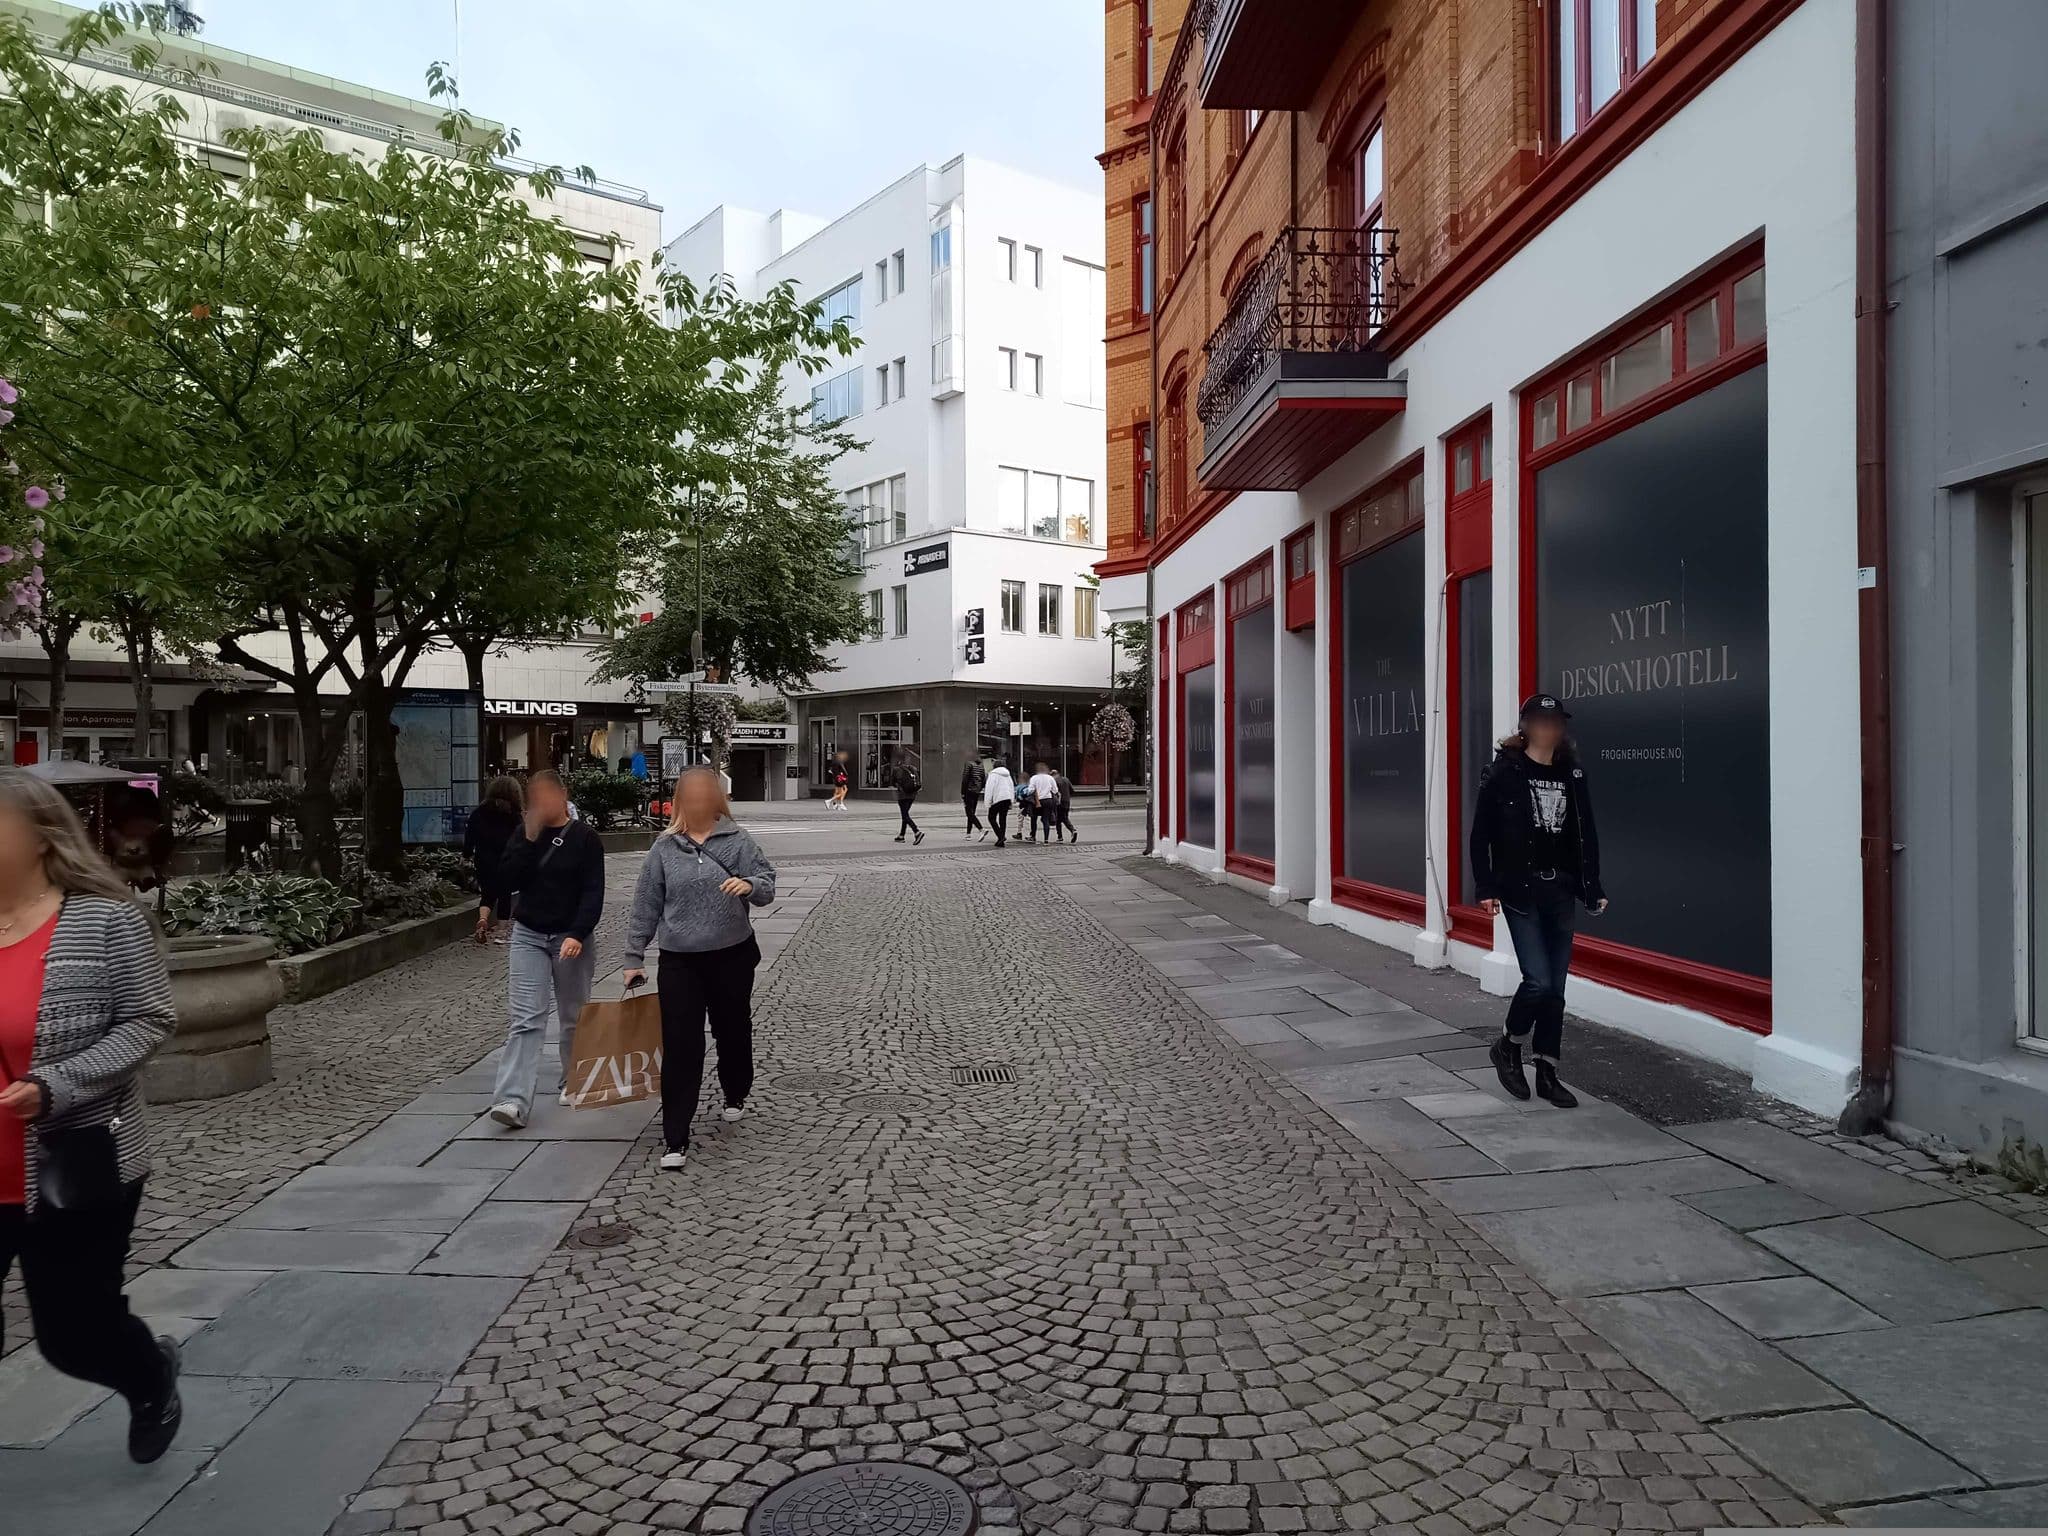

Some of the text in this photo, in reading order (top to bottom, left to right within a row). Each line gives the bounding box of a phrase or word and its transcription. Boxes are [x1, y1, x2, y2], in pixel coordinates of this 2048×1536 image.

[1610, 600, 1672, 644] NYTT
[1561, 645, 1738, 700] DESIGNHOTELL
[82, 715, 134, 724] Apartments
[484, 701, 578, 716] ARLINGS
[1353, 688, 1419, 736] VILLA
[1601, 747, 1682, 760] FROGNERHOUSE.NO
